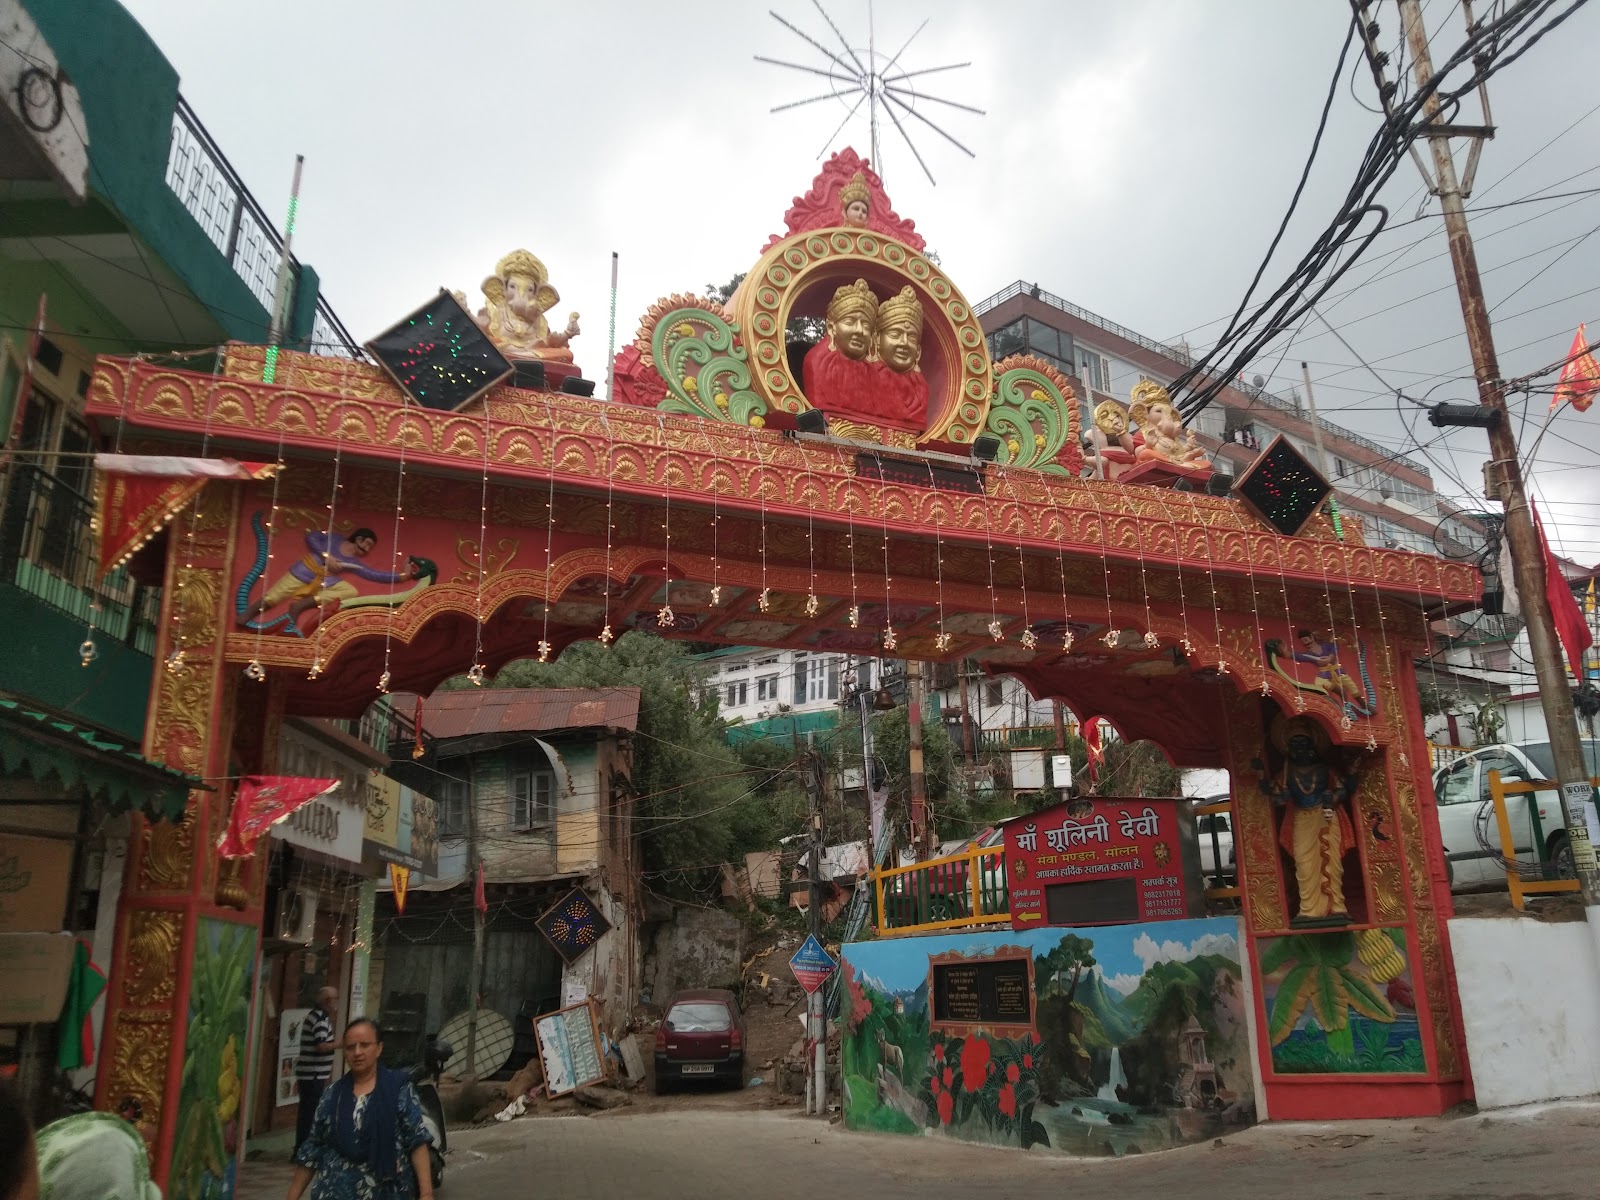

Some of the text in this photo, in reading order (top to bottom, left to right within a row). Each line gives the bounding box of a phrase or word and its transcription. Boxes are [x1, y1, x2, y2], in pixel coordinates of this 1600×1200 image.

[1566, 785, 1591, 794] WORK
[1015, 808, 1160, 852] माँ शूलिनी देवी
[1036, 845, 1139, 866] सेवा मण्डल, सोलन
[1035, 869, 1059, 879] आपका
[1060, 865, 1083, 878] हार्दिक
[1084, 863, 1110, 874] स्वागत
[1111, 861, 1133, 872] करता
[1141, 875, 1179, 888] सम्पर्क सूत्र
